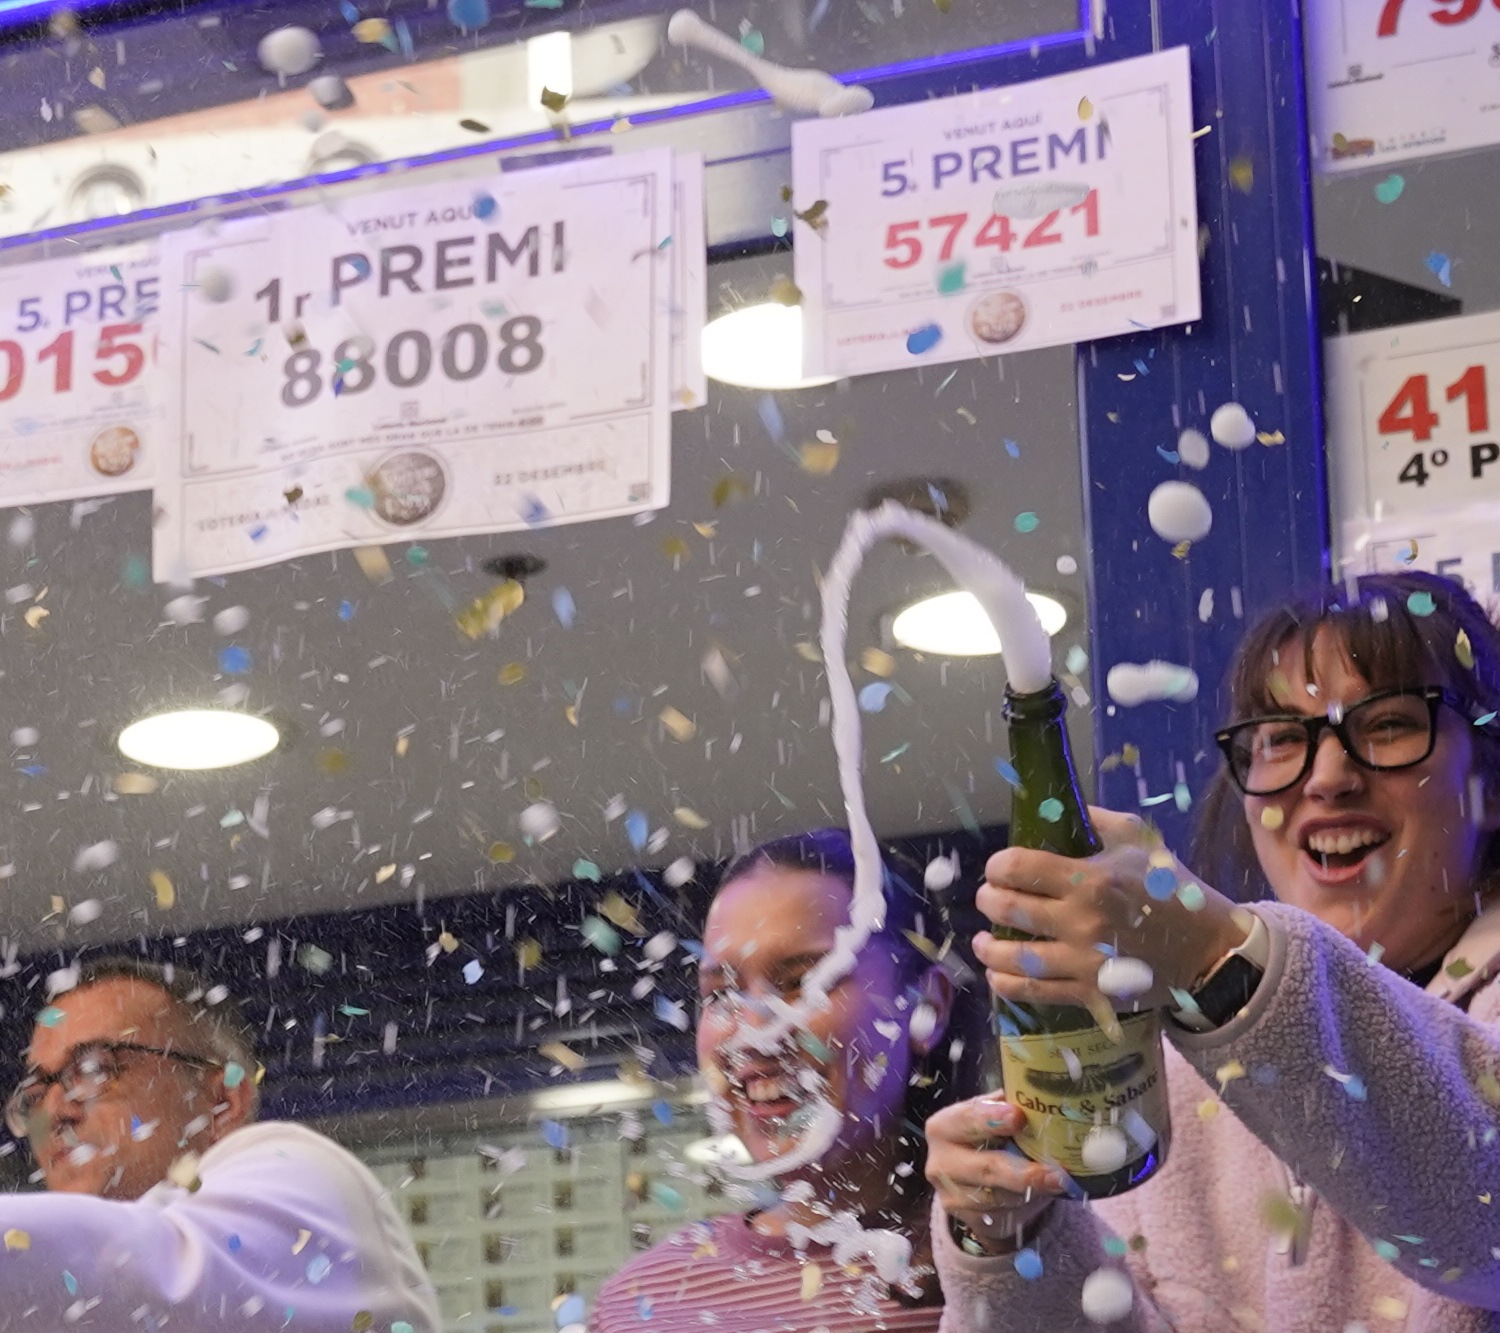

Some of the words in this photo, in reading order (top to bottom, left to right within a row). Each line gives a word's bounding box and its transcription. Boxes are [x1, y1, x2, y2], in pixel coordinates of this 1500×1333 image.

[932, 123, 1108, 190] PREMI
[347, 212, 420, 238] VENUT
[883, 189, 1101, 270] 57421
[254, 277, 312, 325] 1r
[329, 220, 567, 307] PREMI
[279, 313, 544, 409] 88008
